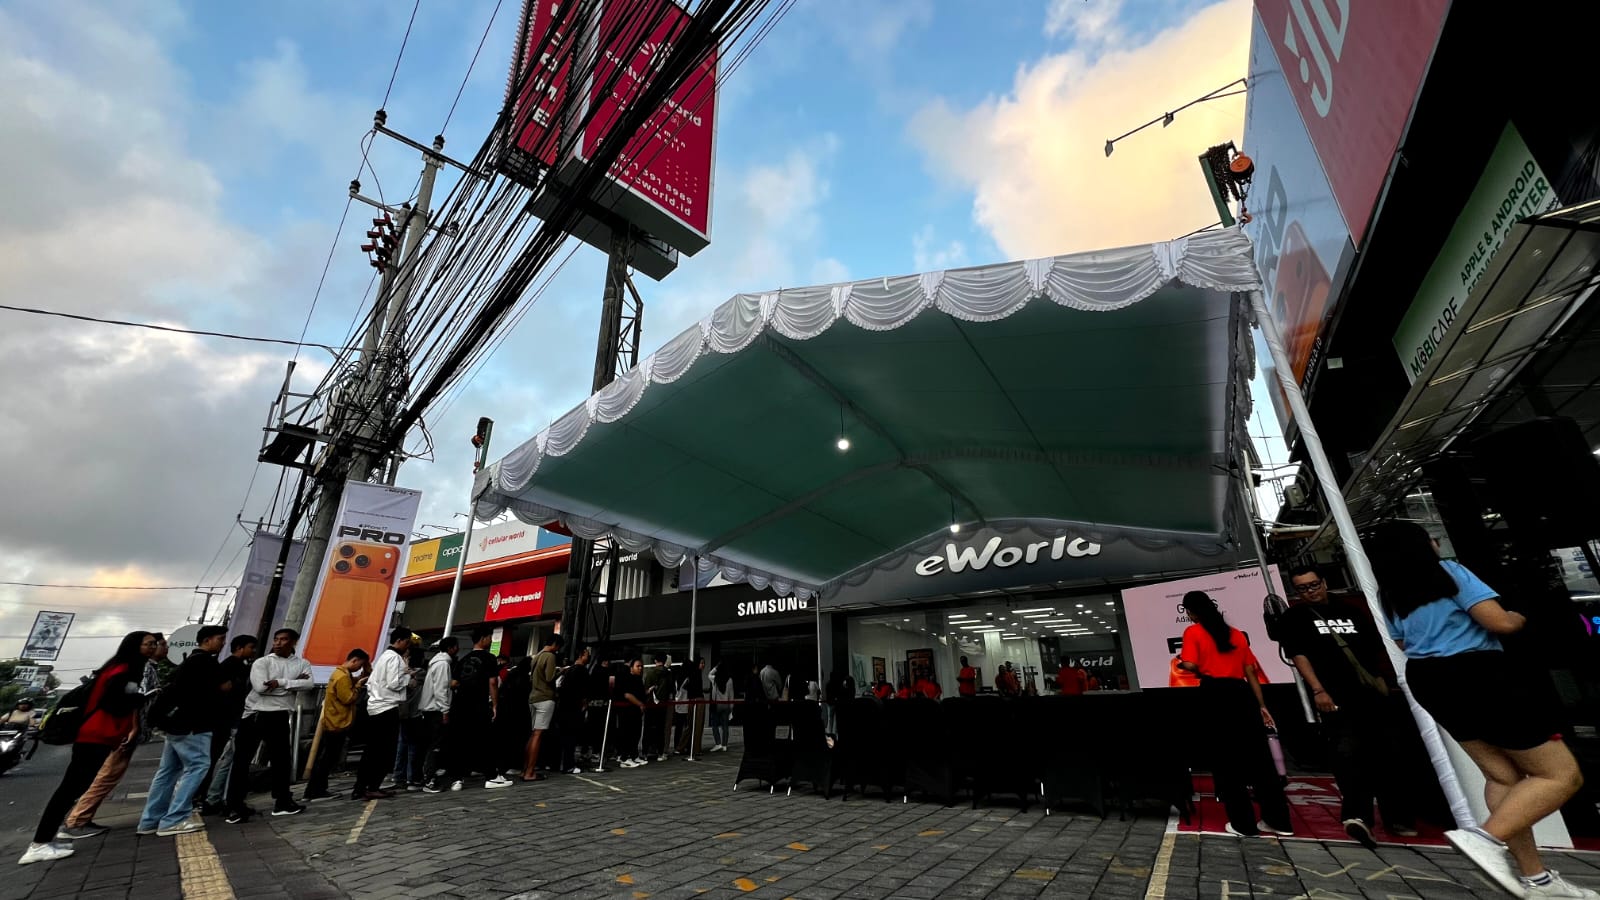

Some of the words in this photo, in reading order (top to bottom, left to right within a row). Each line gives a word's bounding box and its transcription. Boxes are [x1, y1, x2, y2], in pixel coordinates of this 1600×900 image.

[643, 168, 661, 185] 391
[1460, 241, 1487, 286] APPLE
[1484, 231, 1494, 246] &
[1492, 159, 1535, 235] ANDROID
[336, 525, 406, 545] PRO
[488, 535, 508, 545] cellular
[508, 530, 526, 541] world
[500, 595, 523, 605] cellular
[523, 591, 541, 603] world
[737, 596, 808, 617] SAMSUNG
[1313, 619, 1355, 628] BALI
[1317, 626, 1358, 635] BMX
